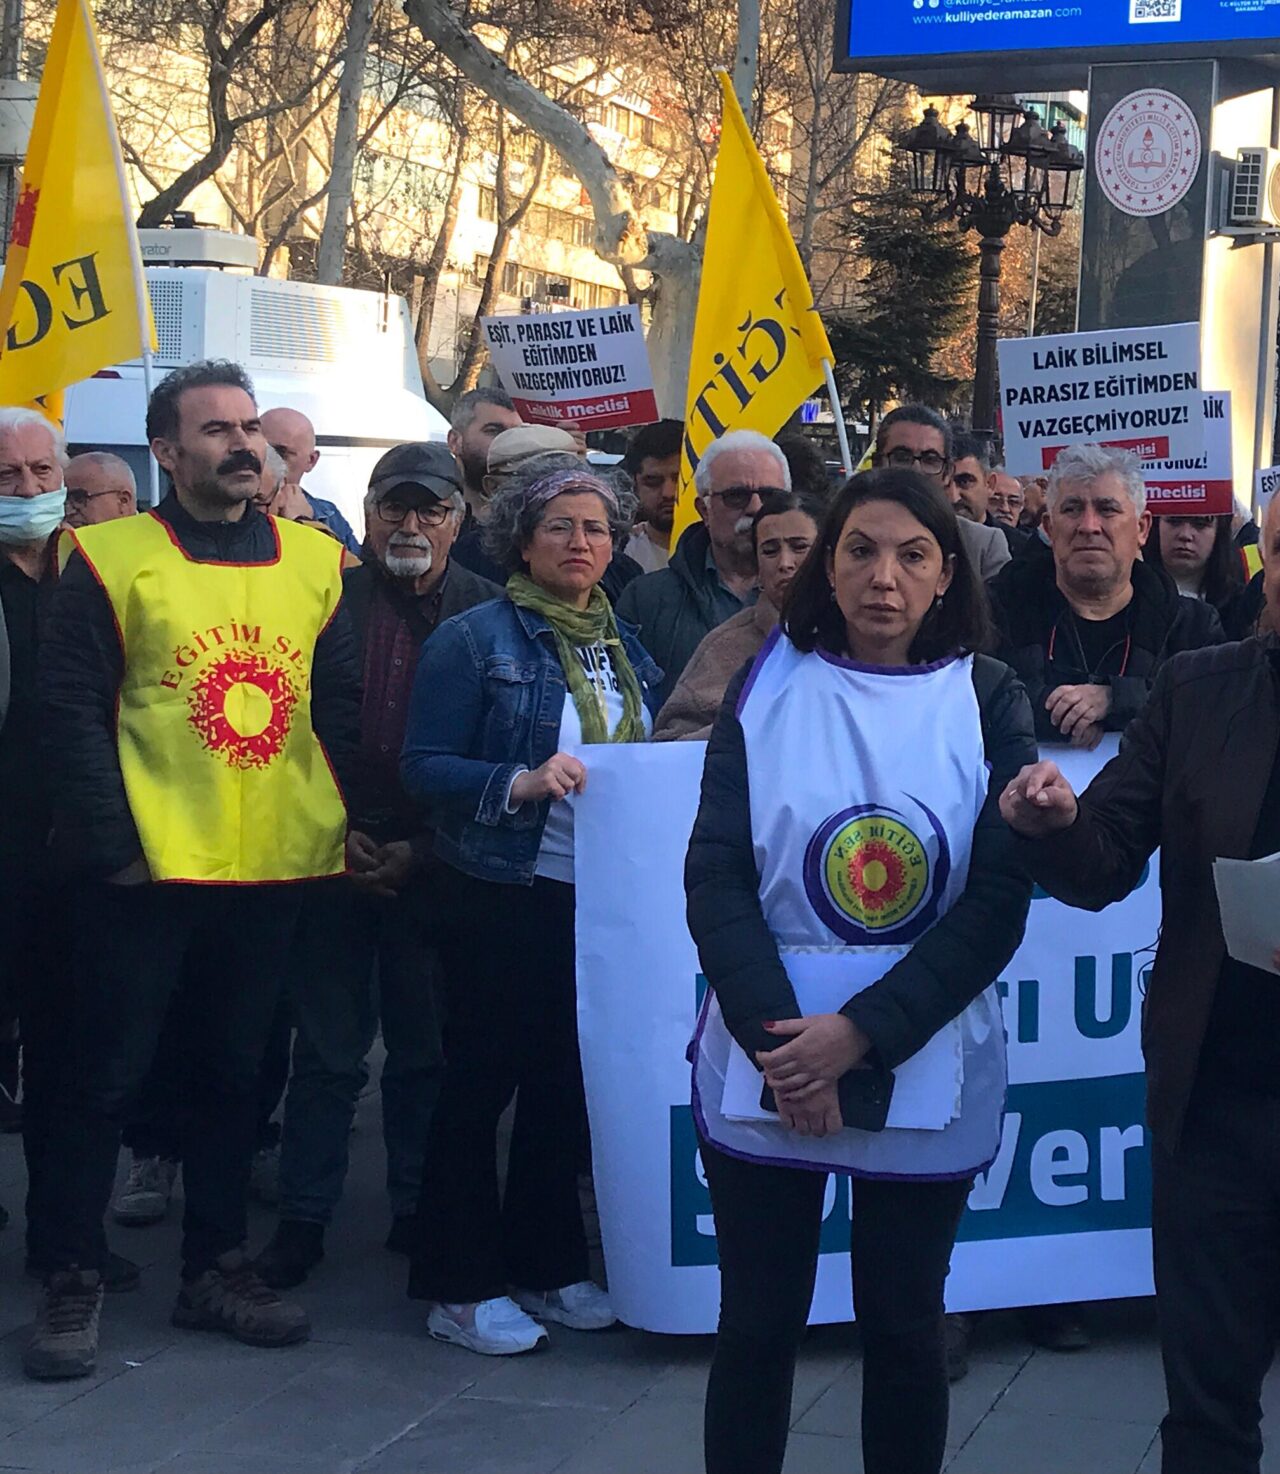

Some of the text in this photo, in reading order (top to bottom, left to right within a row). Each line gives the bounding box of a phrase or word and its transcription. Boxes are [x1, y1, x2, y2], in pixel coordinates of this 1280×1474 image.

[487, 311, 635, 348] EŞİT, PARASIZ VE LAİK
[522, 343, 598, 367] EĞİTİMDEN
[1033, 341, 1168, 370] LAİK BİLİMSEL
[512, 364, 627, 396] VAZGEÇMİYORUZ!
[1006, 371, 1198, 406] PARASIZ EĞİTİMDEN
[1018, 405, 1189, 439] VAZGEÇMİYORUZ!
[160, 618, 262, 690] EĞİTİM
